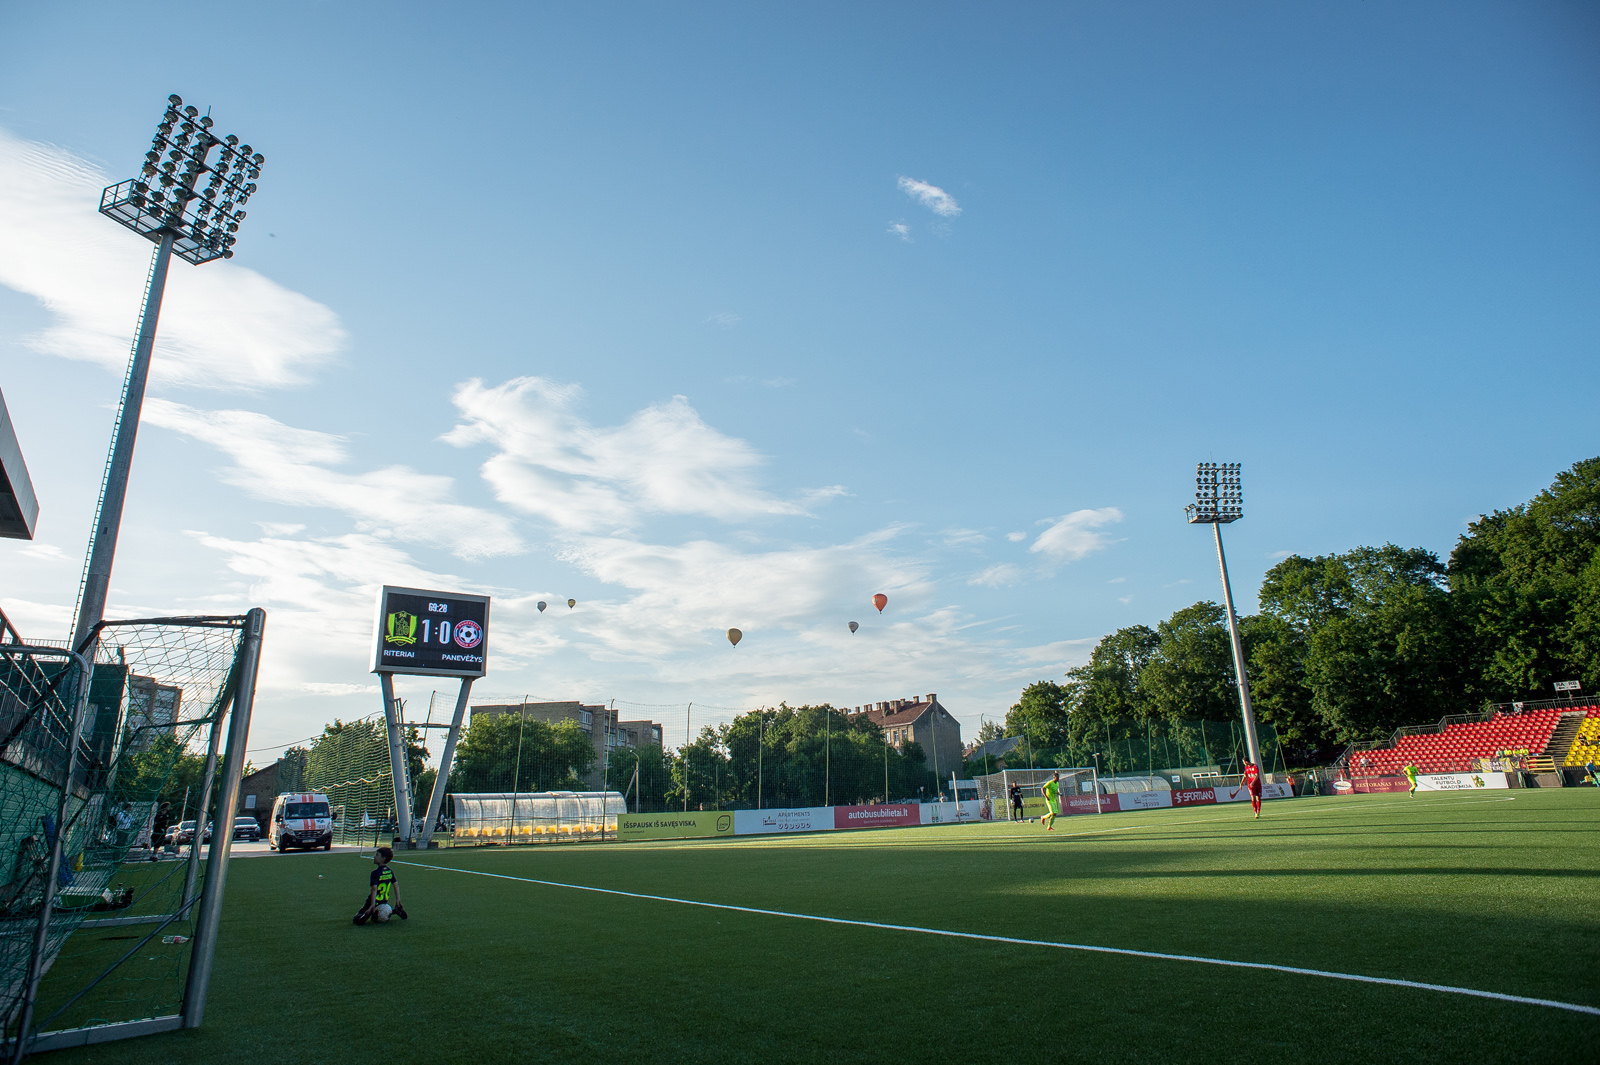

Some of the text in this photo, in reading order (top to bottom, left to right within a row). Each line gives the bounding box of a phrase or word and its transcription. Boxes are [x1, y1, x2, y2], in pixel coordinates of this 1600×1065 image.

[428, 602, 448, 613] 69:28
[383, 649, 415, 658] RITERIAI
[441, 653, 483, 663] PANEVĖŽYS
[1183, 791, 1214, 802] SPORTLAND
[848, 808, 909, 819] autobusubilietai.lt
[623, 821, 653, 829] IŠSPAUSK
[653, 820, 660, 828] IŠ
[679, 820, 697, 828] VISKĄ
